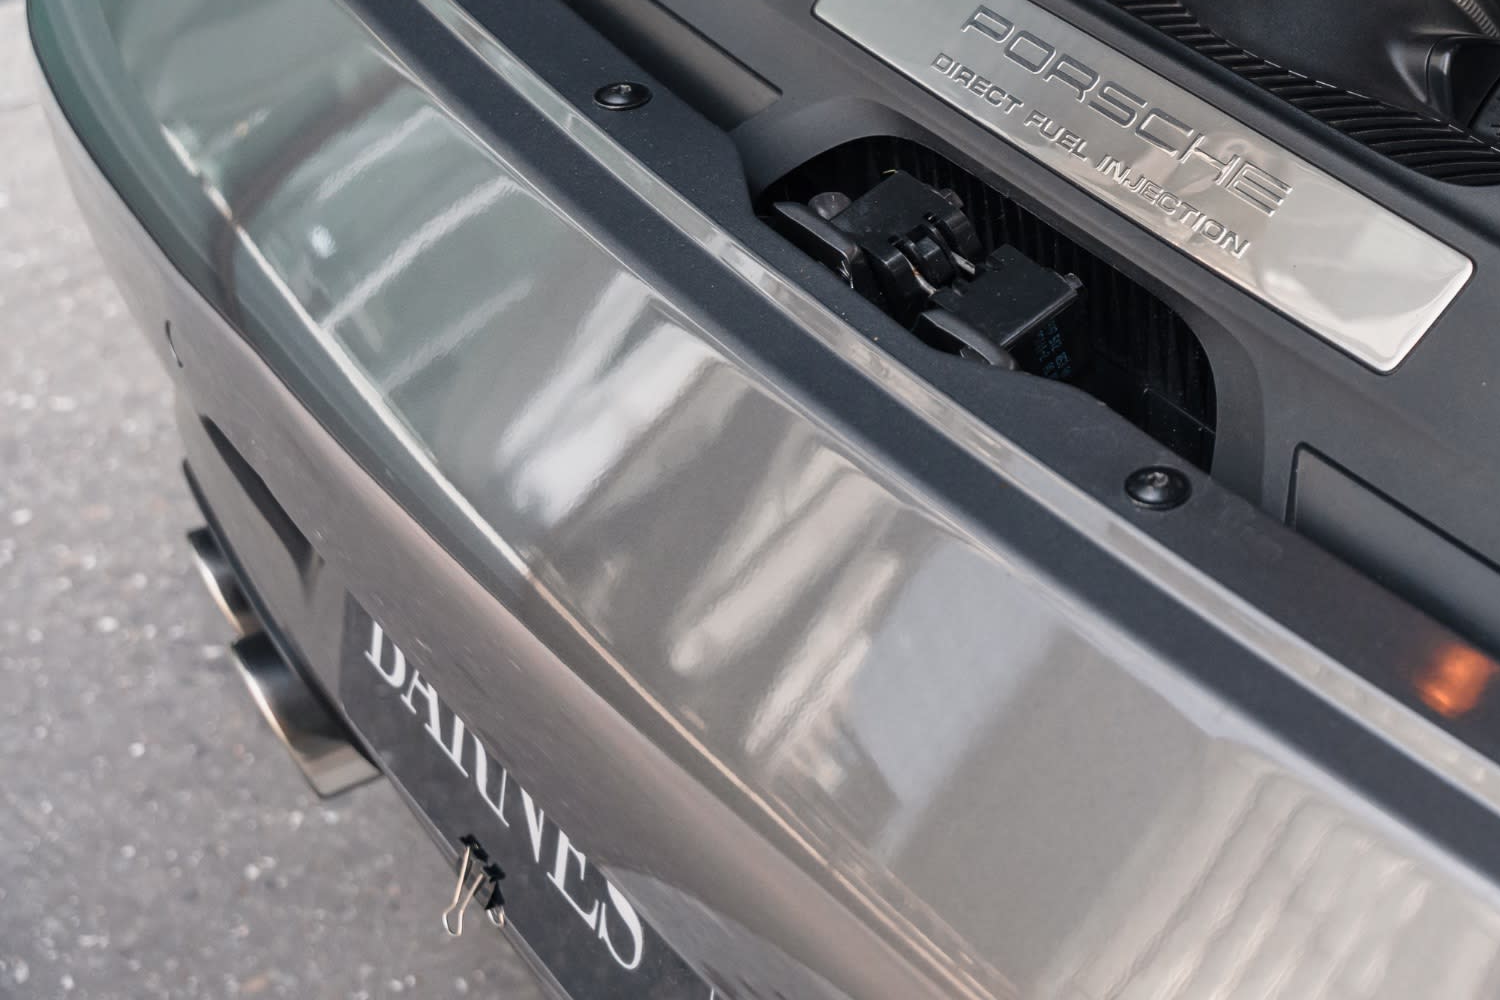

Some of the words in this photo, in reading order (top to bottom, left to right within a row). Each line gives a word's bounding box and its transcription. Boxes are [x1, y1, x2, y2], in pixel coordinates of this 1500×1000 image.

[930, 52, 1024, 115] DIRECT
[1023, 109, 1090, 161] FUEL
[1096, 154, 1251, 259] INJECTION
[960, 4, 1293, 217] PORSCHE
